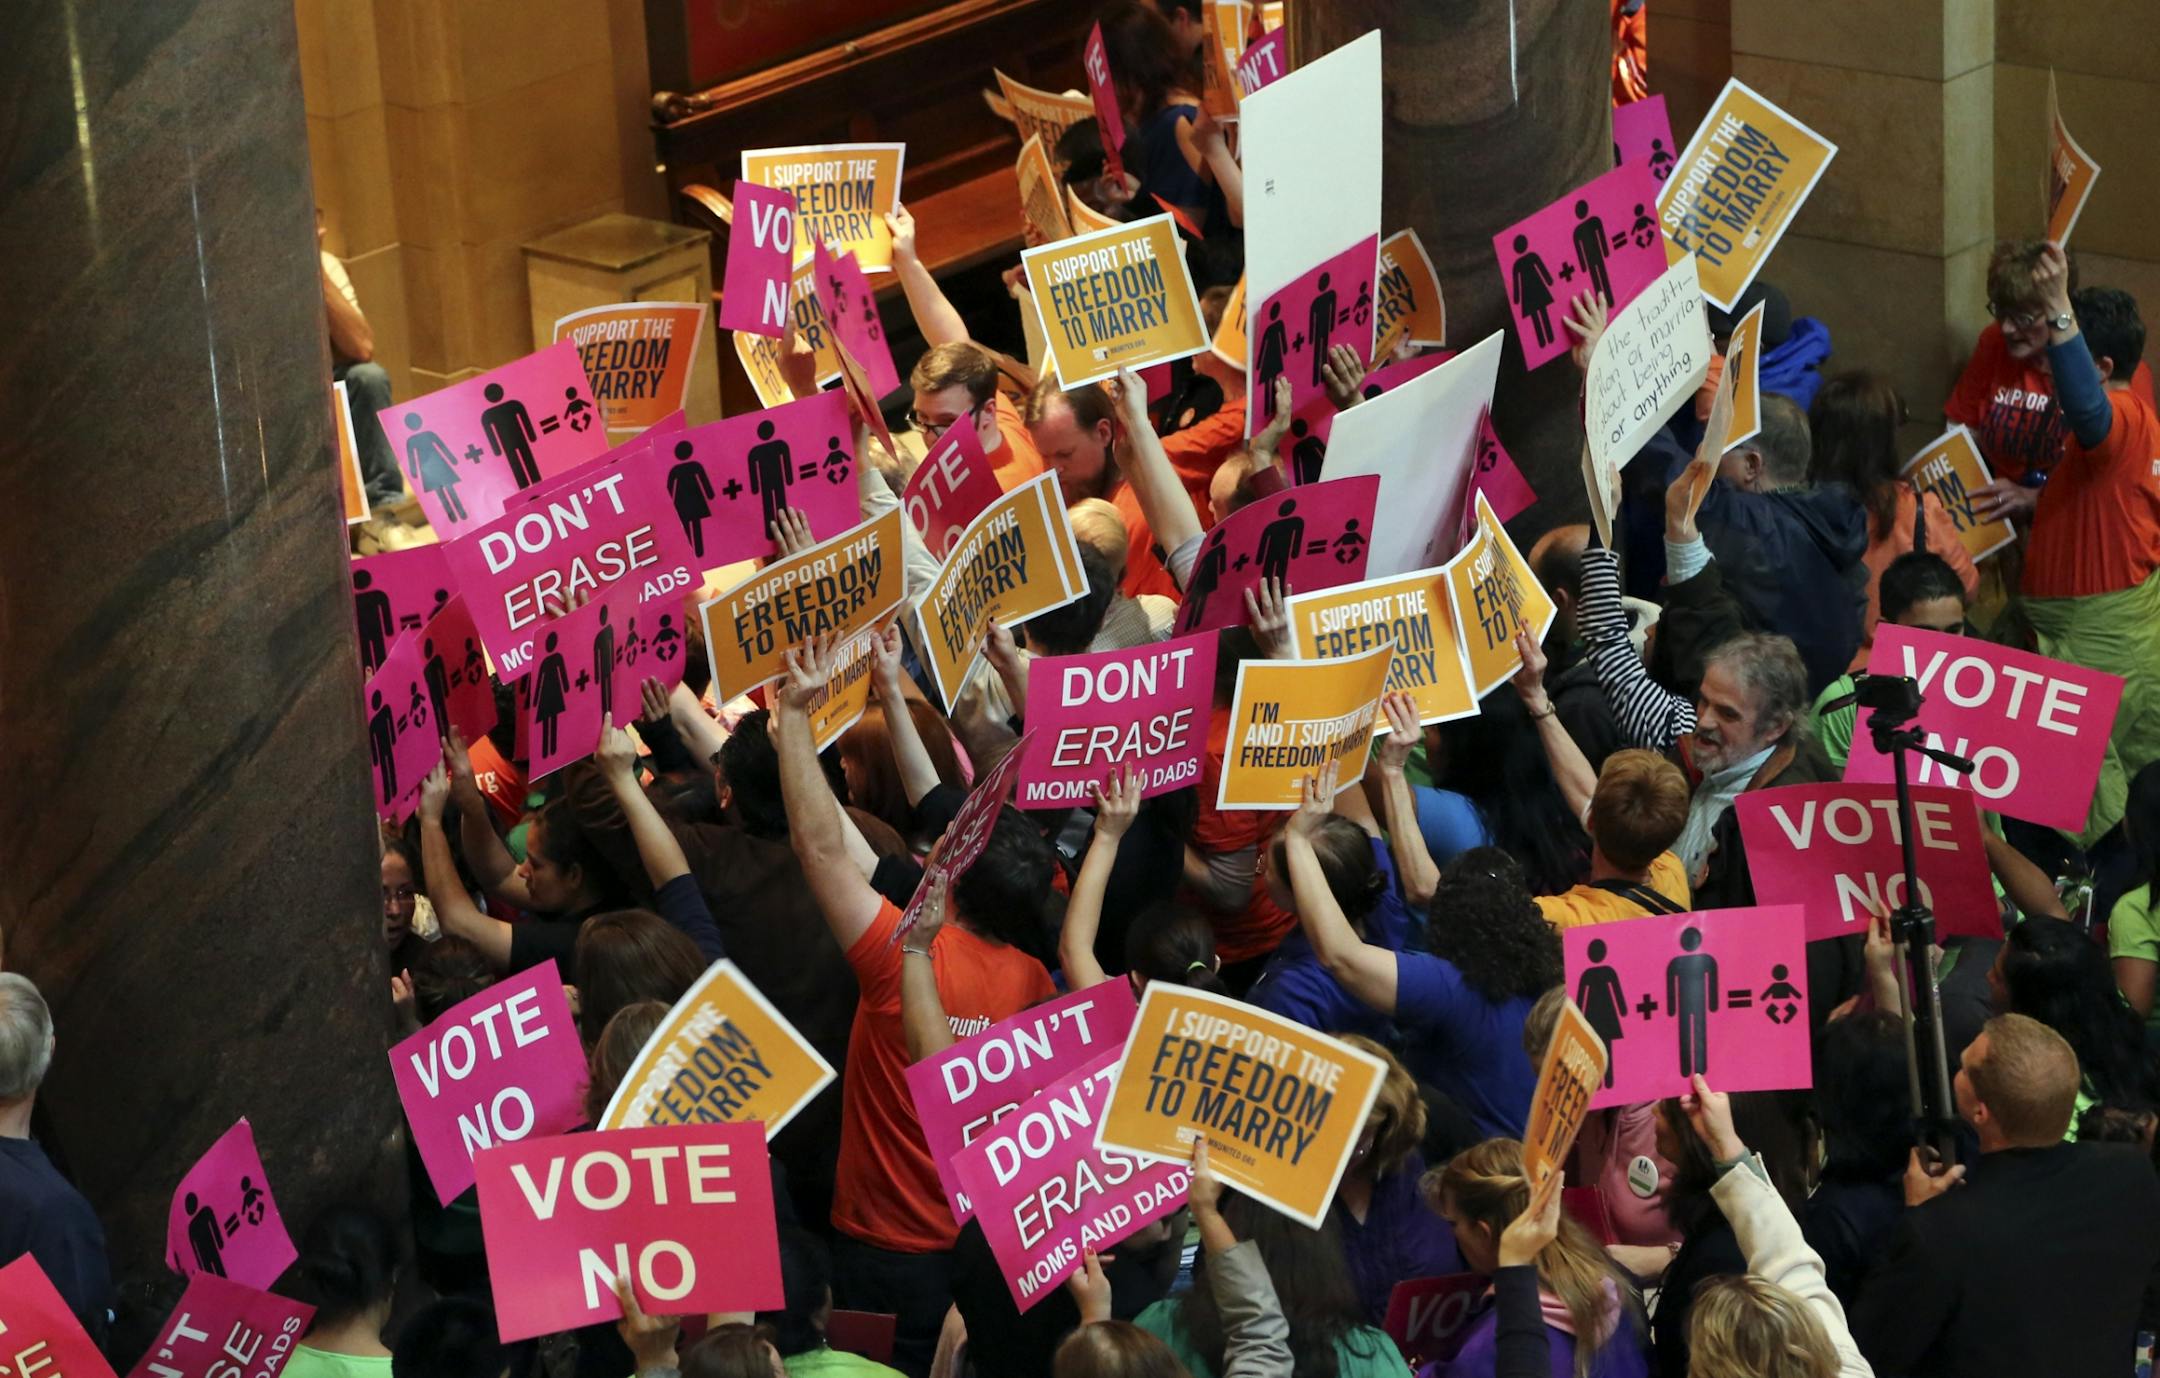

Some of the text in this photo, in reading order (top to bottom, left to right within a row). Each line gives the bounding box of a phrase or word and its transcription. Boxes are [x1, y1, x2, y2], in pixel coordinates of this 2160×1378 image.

[774, 160, 843, 186] SUPPORT
[846, 159, 878, 180] THE
[1663, 145, 1721, 229] SUPPORT
[1711, 112, 1745, 149] THE
[1671, 123, 1769, 253] FREEDOM
[750, 199, 795, 255] VO
[1695, 229, 1734, 268] TO
[1719, 140, 1791, 235] MARRY
[1043, 236, 1156, 286] I SUPPORT THE
[1050, 258, 1166, 319] FREEDOM
[572, 317, 675, 348] SUPPORT THE
[761, 278, 788, 328] N
[1060, 292, 1170, 350] TO MARRY
[1607, 327, 1631, 360] the
[1627, 344, 1646, 369] of
[1635, 342, 1675, 391] being
[1633, 351, 1693, 419] anything
[907, 440, 972, 537] OTE
[1921, 452, 1955, 486] THE
[479, 472, 625, 575] DON'T
[504, 525, 658, 632] ERASE
[640, 566, 691, 604] ADS
[731, 530, 880, 619] I SUPPORT THE
[934, 507, 1020, 617] I SUPPORT THE
[939, 525, 1027, 645] FREEDOM
[1467, 566, 1475, 589] I
[735, 546, 882, 644] FREEDOM
[739, 573, 881, 665] TO MARRY
[946, 627, 965, 664] TO
[963, 554, 1029, 635] MARRY
[1309, 589, 1429, 636] I SUPPORT THE
[500, 640, 534, 673] MO
[1481, 610, 1508, 651] TO
[831, 673, 843, 698] TO
[843, 652, 872, 690] MARRY
[1061, 647, 1194, 707] DON'T
[1384, 651, 1439, 694] ARRY
[1901, 644, 2088, 737] VOTE
[1051, 707, 1194, 767] ERASE
[1244, 723, 1283, 746] AND
[1288, 723, 1297, 746] I
[1300, 708, 1363, 746] SUPPORT
[1251, 702, 1280, 724] I'M
[1026, 780, 1101, 801] MOMS
[1152, 757, 1198, 789] DADS
[1239, 745, 1327, 768] FREEDOM
[1918, 732, 2021, 799] NO
[1769, 797, 1959, 852] VOTE
[1834, 871, 1934, 923] NO
[410, 986, 551, 1099] VOTE
[677, 1001, 729, 1046] THE
[940, 1000, 1095, 1104] DON'T
[1164, 1007, 1345, 1094] I SUPPORT THE
[1151, 1034, 1335, 1133] FREEDOM
[457, 1086, 536, 1164] NO
[1144, 1075, 1317, 1167] TO MARRY
[509, 1142, 737, 1222] VOTE
[1012, 1150, 1160, 1251] ERAS
[1016, 1165, 1196, 1299] MOMS AND DADS
[577, 1238, 698, 1311] NO
[1405, 1289, 1472, 1343] VO
